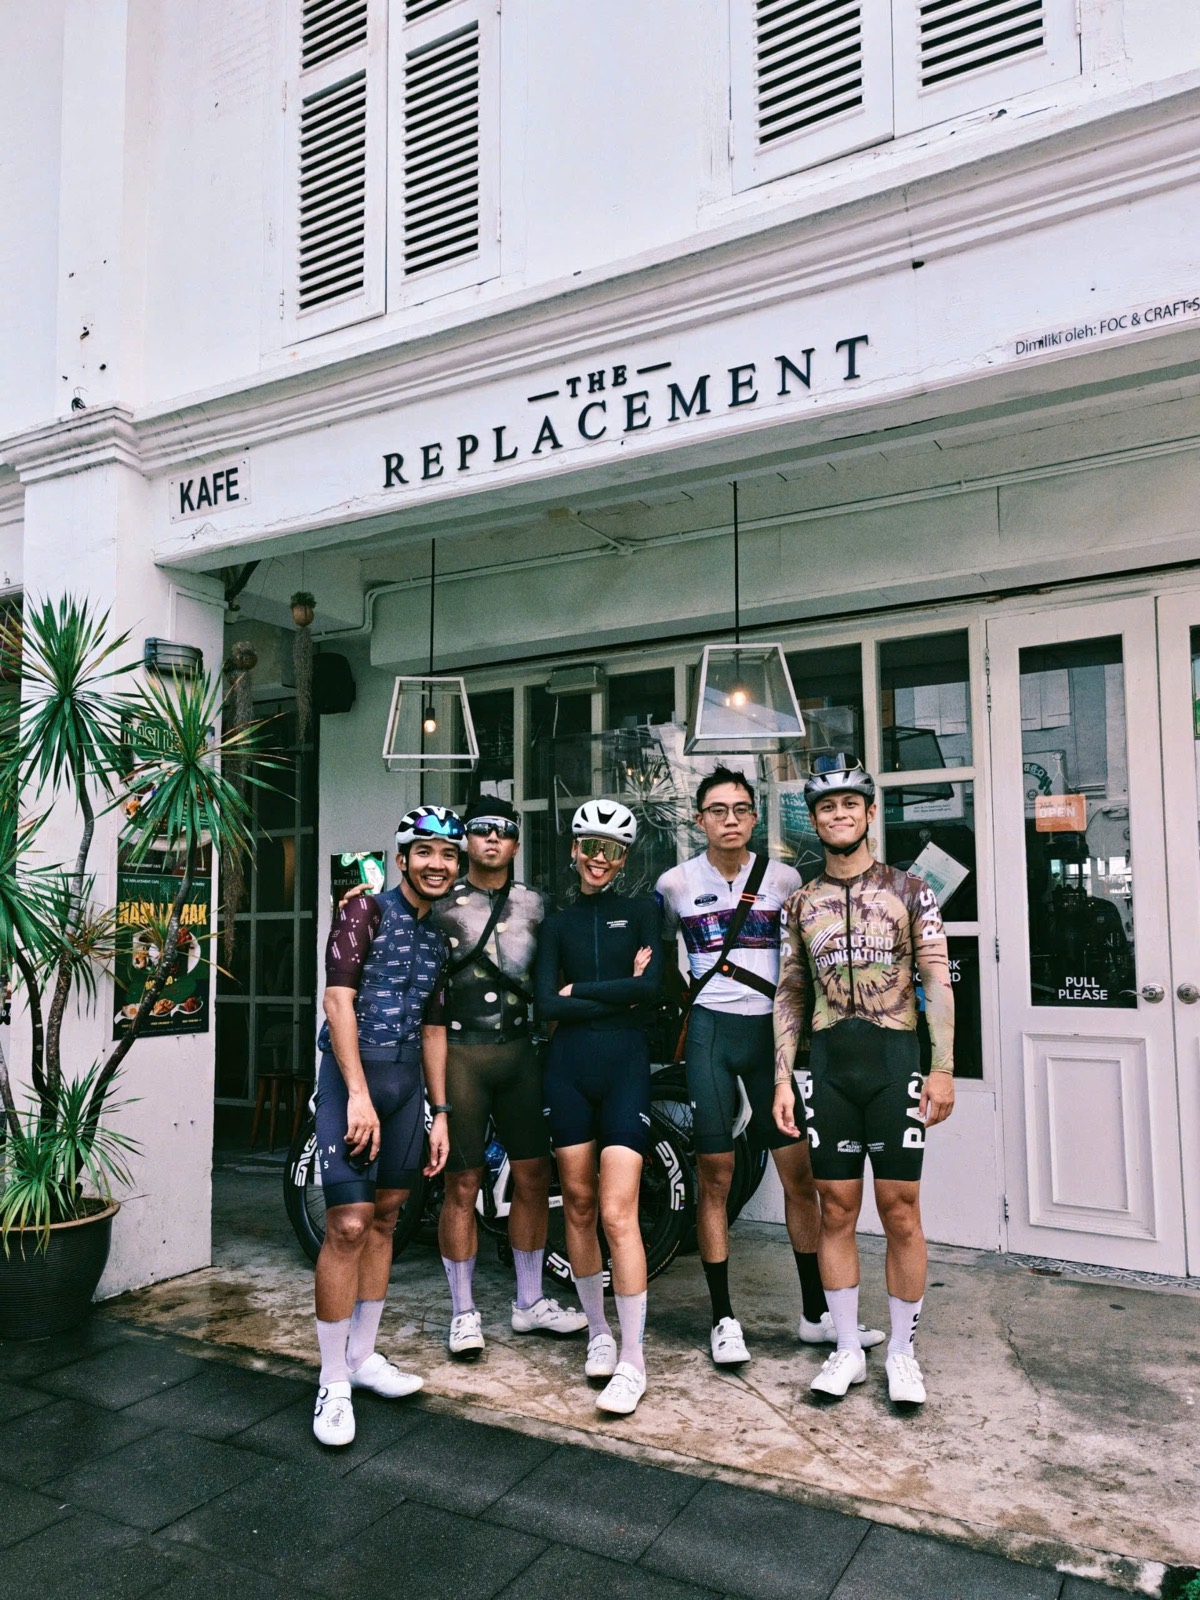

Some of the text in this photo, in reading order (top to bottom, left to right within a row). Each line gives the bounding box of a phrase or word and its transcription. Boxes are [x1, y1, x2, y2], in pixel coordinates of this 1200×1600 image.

[1015, 331, 1062, 355] Dimiliki
[1064, 324, 1097, 343] oleh:
[1100, 314, 1128, 334] FOC
[1130, 312, 1141, 326] &
[1144, 299, 1189, 323] CRAFT
[566, 364, 628, 398] THE
[382, 334, 869, 489] REPLACEMENT
[179, 466, 240, 514] KAFE
[1039, 807, 1076, 818] OPEN
[118, 901, 156, 925] NASI
[920, 888, 945, 941] PAS
[855, 920, 893, 937] STEVE
[815, 950, 893, 971] FOUNDATION
[1058, 988, 1108, 1000] PLEASE
[1065, 976, 1100, 988] PULL
